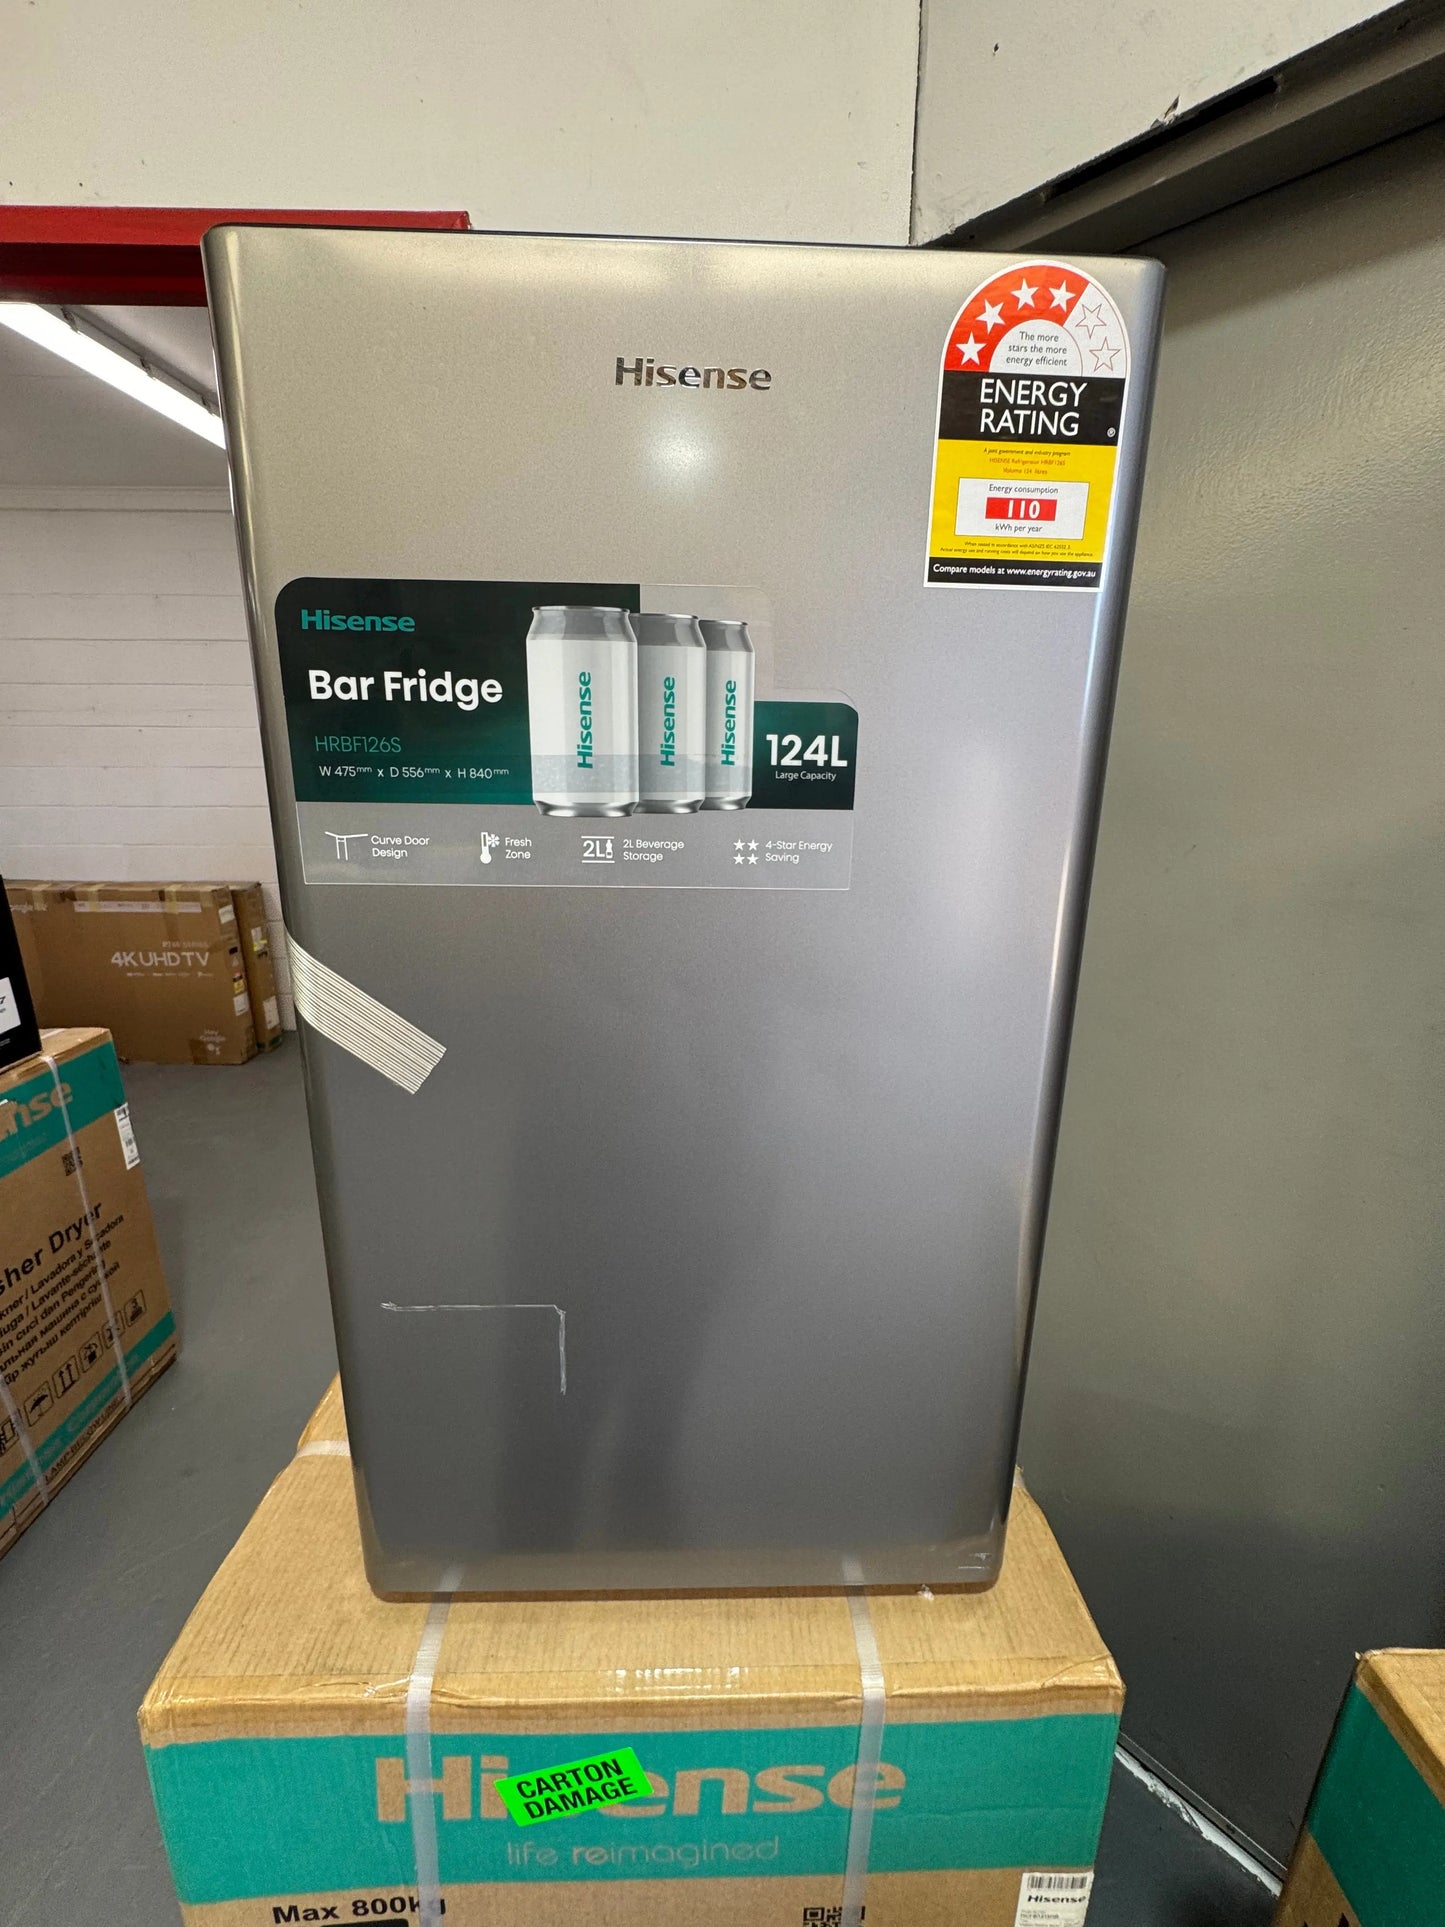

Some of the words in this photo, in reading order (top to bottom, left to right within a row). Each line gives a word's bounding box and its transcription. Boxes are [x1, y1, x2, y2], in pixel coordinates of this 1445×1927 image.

[1020, 331, 1034, 342] The
[1037, 334, 1059, 342] more
[1008, 344, 1028, 353] stars
[1030, 344, 1043, 353] the
[1045, 346, 1067, 354] more
[1006, 356, 1033, 366] energy
[1036, 356, 1067, 366] efficient
[615, 356, 772, 390] Hisense
[980, 378, 1088, 407] ENERGY
[980, 408, 1080, 436] RATING
[989, 484, 1012, 494] Energy
[1014, 486, 1058, 494] consumption
[1007, 500, 1040, 519] 110
[995, 523, 1012, 532] kWh
[1014, 525, 1026, 533] per
[1027, 526, 1042, 534] year
[933, 564, 967, 574] Compare
[969, 564, 996, 574] models
[1007, 567, 1096, 578] www.energyrating.gov.au
[301, 609, 415, 632] Hisense
[308, 670, 374, 700] Bar
[384, 668, 503, 711] Fridge
[576, 671, 593, 769] Hisense
[660, 676, 676, 767] Hisense
[721, 680, 737, 766] Hisense
[314, 736, 402, 753] HRBF126S
[766, 734, 848, 767] 124L
[319, 766, 332, 777] W
[334, 765, 372, 777] 475mm
[377, 768, 384, 777] x
[390, 767, 399, 778] D
[402, 767, 440, 778] 556mm
[445, 769, 452, 778] x
[458, 768, 466, 778] H
[469, 768, 509, 779] 840mm
[775, 771, 798, 781] Large
[800, 771, 836, 782] Capacity
[371, 836, 402, 846] Curve
[404, 836, 430, 846] Door
[505, 837, 532, 847] Fresh
[623, 840, 634, 849] 2L
[636, 840, 684, 850] Beverage
[765, 841, 796, 850] 4-Star
[798, 841, 832, 853] Energy
[372, 848, 408, 859] Design
[506, 850, 531, 859] Zone
[623, 852, 663, 862] Storage
[765, 853, 799, 864] Saving
[111, 951, 138, 967] 4K
[84, 1214, 124, 1250] Scadora
[374, 1753, 907, 1823] Hiense
[515, 1758, 624, 1802] CARTON
[523, 1776, 638, 1822] DAMAGE
[507, 1840, 558, 1866] life
[571, 1836, 780, 1868] reimagined
[1027, 1894, 1087, 1904] Hisense
[272, 1905, 340, 1925] Max
[351, 1895, 446, 1918] 800k
